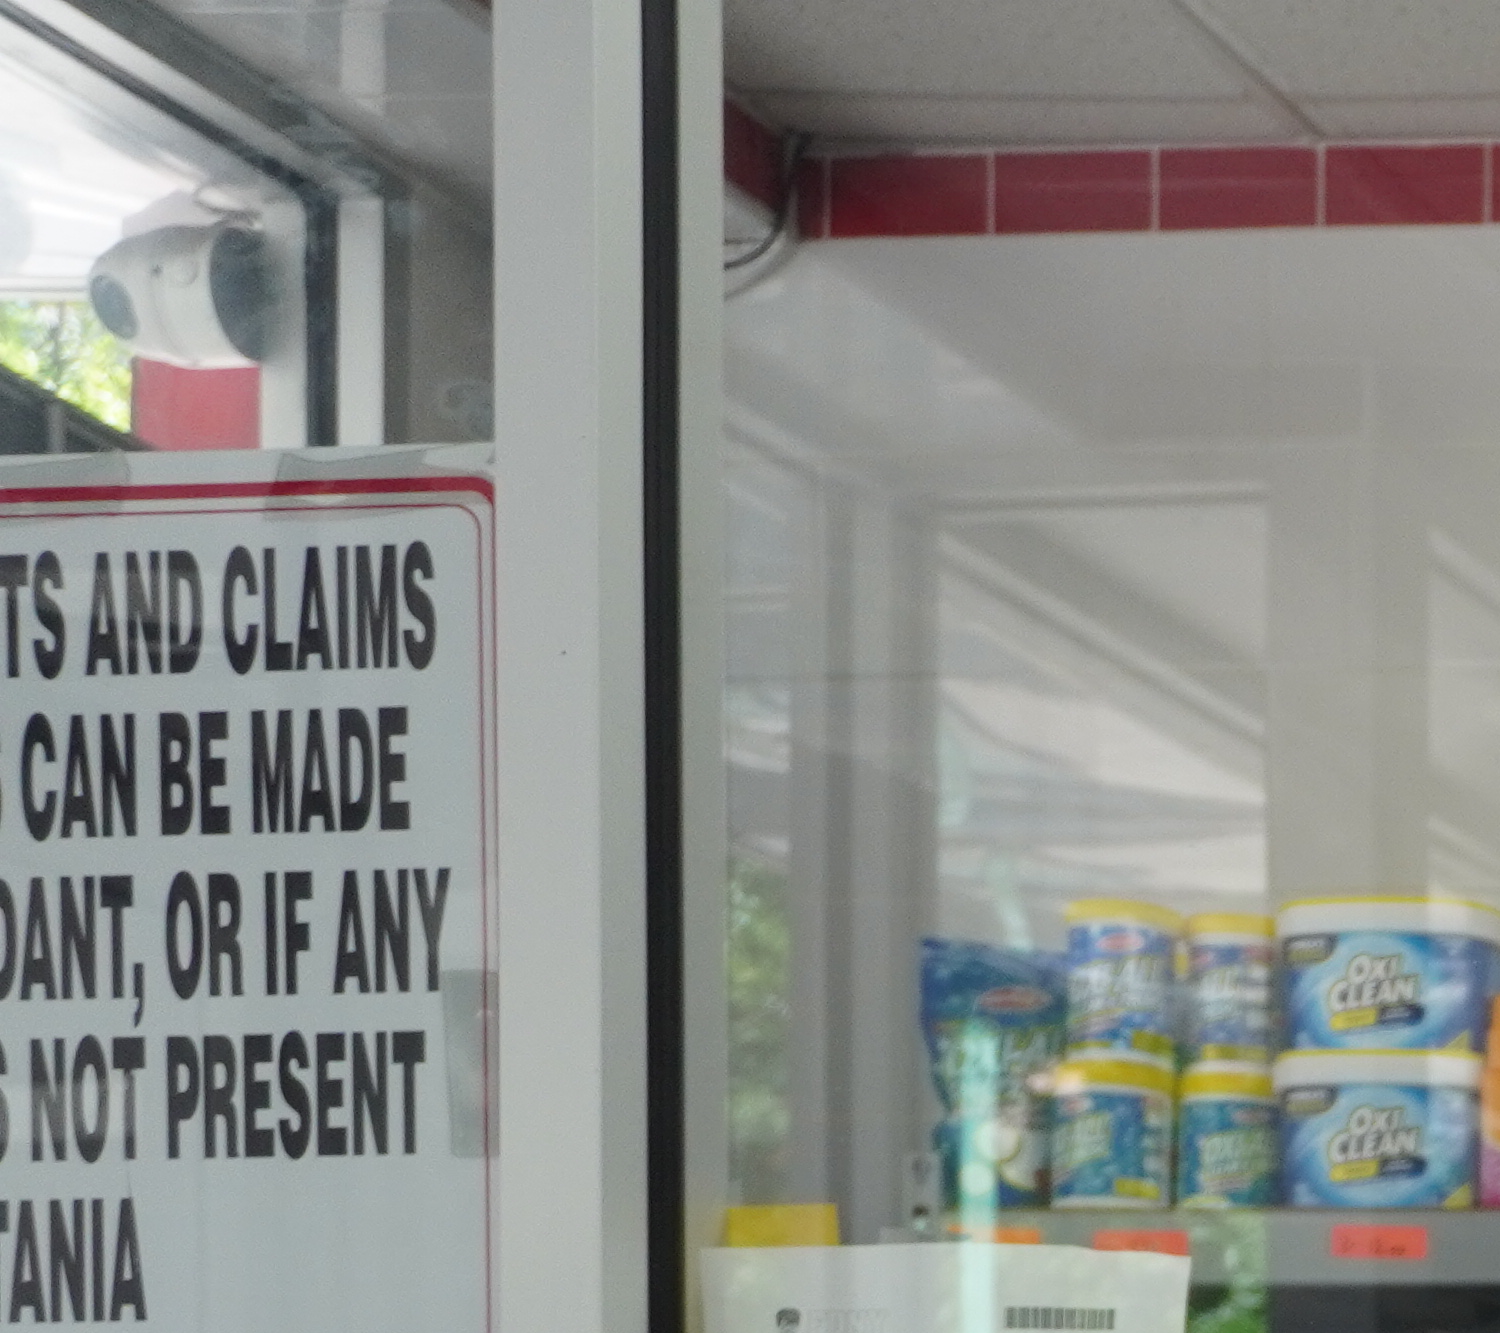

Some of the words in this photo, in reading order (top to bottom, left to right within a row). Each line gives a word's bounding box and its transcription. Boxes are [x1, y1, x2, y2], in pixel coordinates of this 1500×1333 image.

[86, 550, 203, 677] AND
[223, 541, 436, 676] CLAIMS
[20, 712, 137, 841] CAN
[158, 711, 231, 836] BE
[250, 707, 411, 834] MADE
[165, 870, 243, 1000] OR
[264, 870, 313, 995] IF
[333, 868, 451, 993] ANY
[1328, 974, 1420, 1012] CLEAN
[30, 1035, 146, 1163] NOT
[166, 1030, 427, 1160] PRESENT
[1328, 1127, 1421, 1164] CLEAN
[0, 1198, 148, 1323] ANIA
